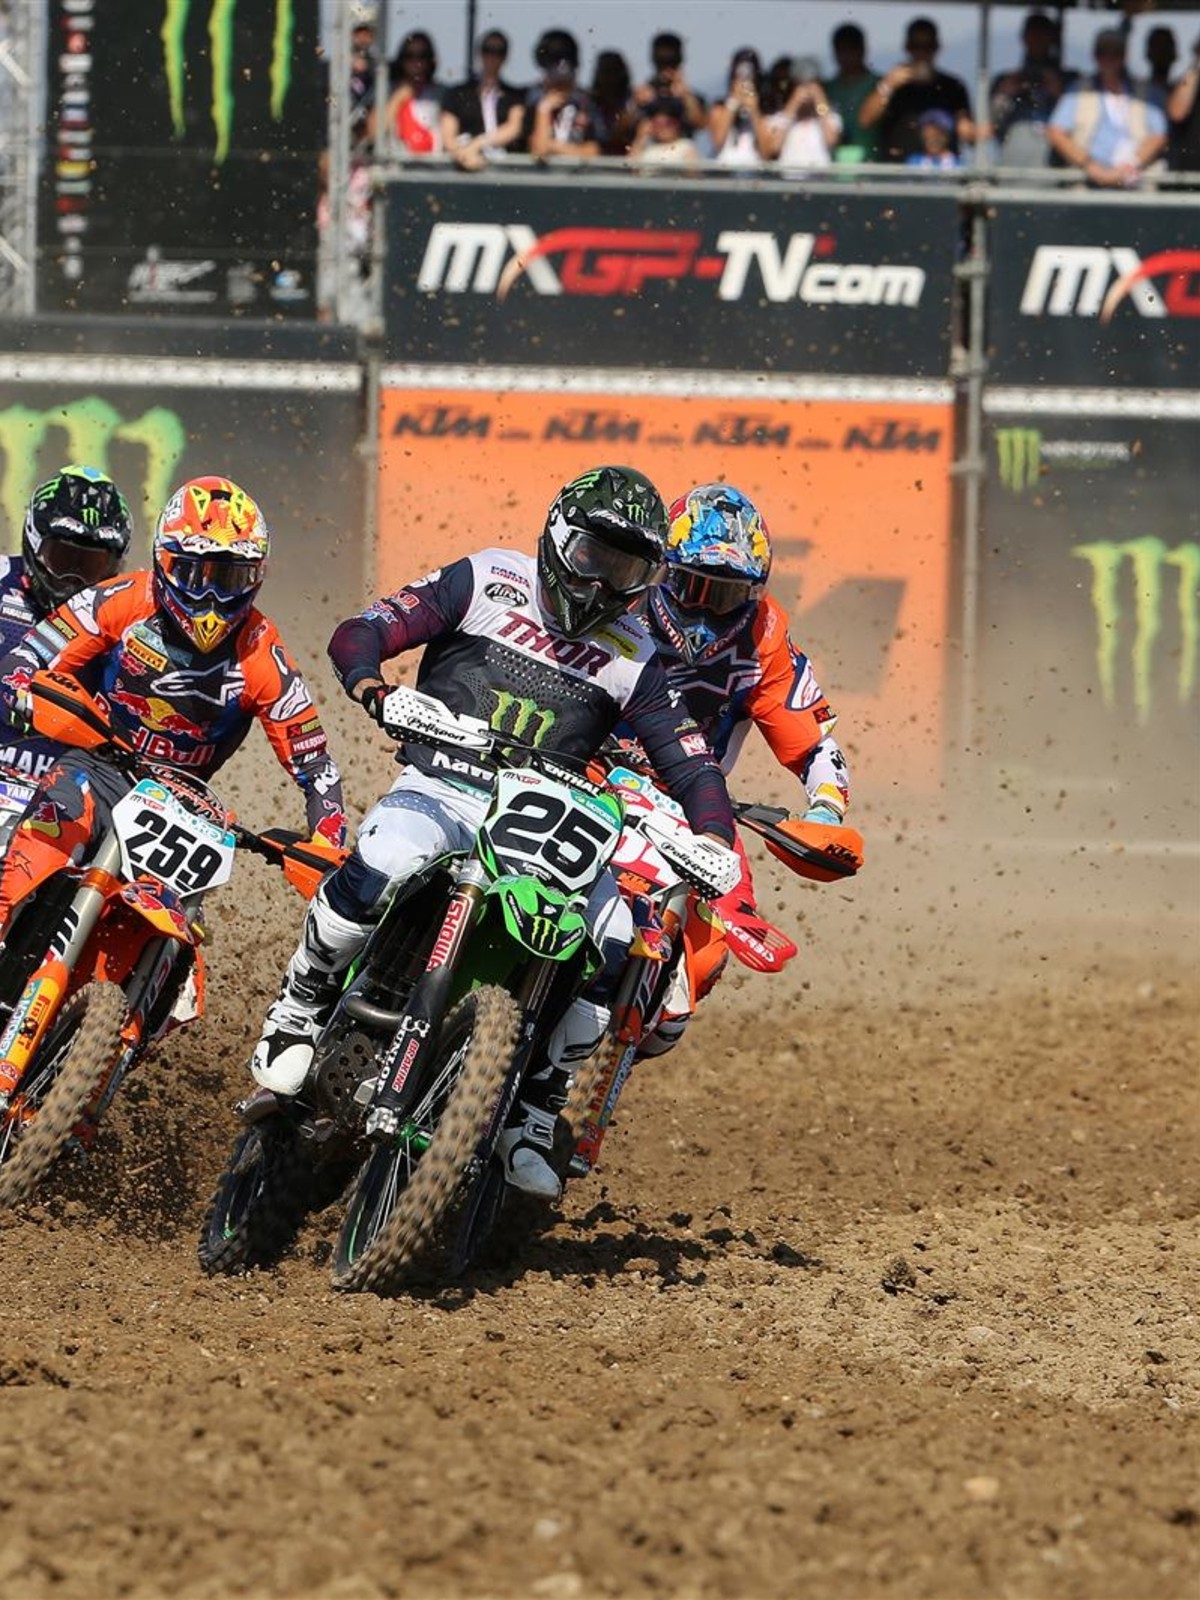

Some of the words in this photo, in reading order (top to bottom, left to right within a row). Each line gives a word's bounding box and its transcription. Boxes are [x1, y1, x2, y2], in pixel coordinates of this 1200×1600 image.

[394, 405, 491, 441] KTM
[544, 409, 642, 444] KTM
[693, 413, 792, 449] KTM
[844, 417, 941, 453] KTM
[496, 610, 612, 677] THOR
[44, 671, 82, 693] KTM
[407, 715, 467, 742] Polisport
[502, 770, 542, 785] MXGP
[124, 809, 224, 892] 259
[489, 790, 613, 879] 25
[823, 843, 860, 865] KTM
[660, 840, 720, 885] Polisport
[425, 897, 470, 973] SHOWA
[723, 919, 776, 964] ACERBIS
[391, 1037, 421, 1094] BRAKING
[605, 1044, 638, 1110] MOTOREX
